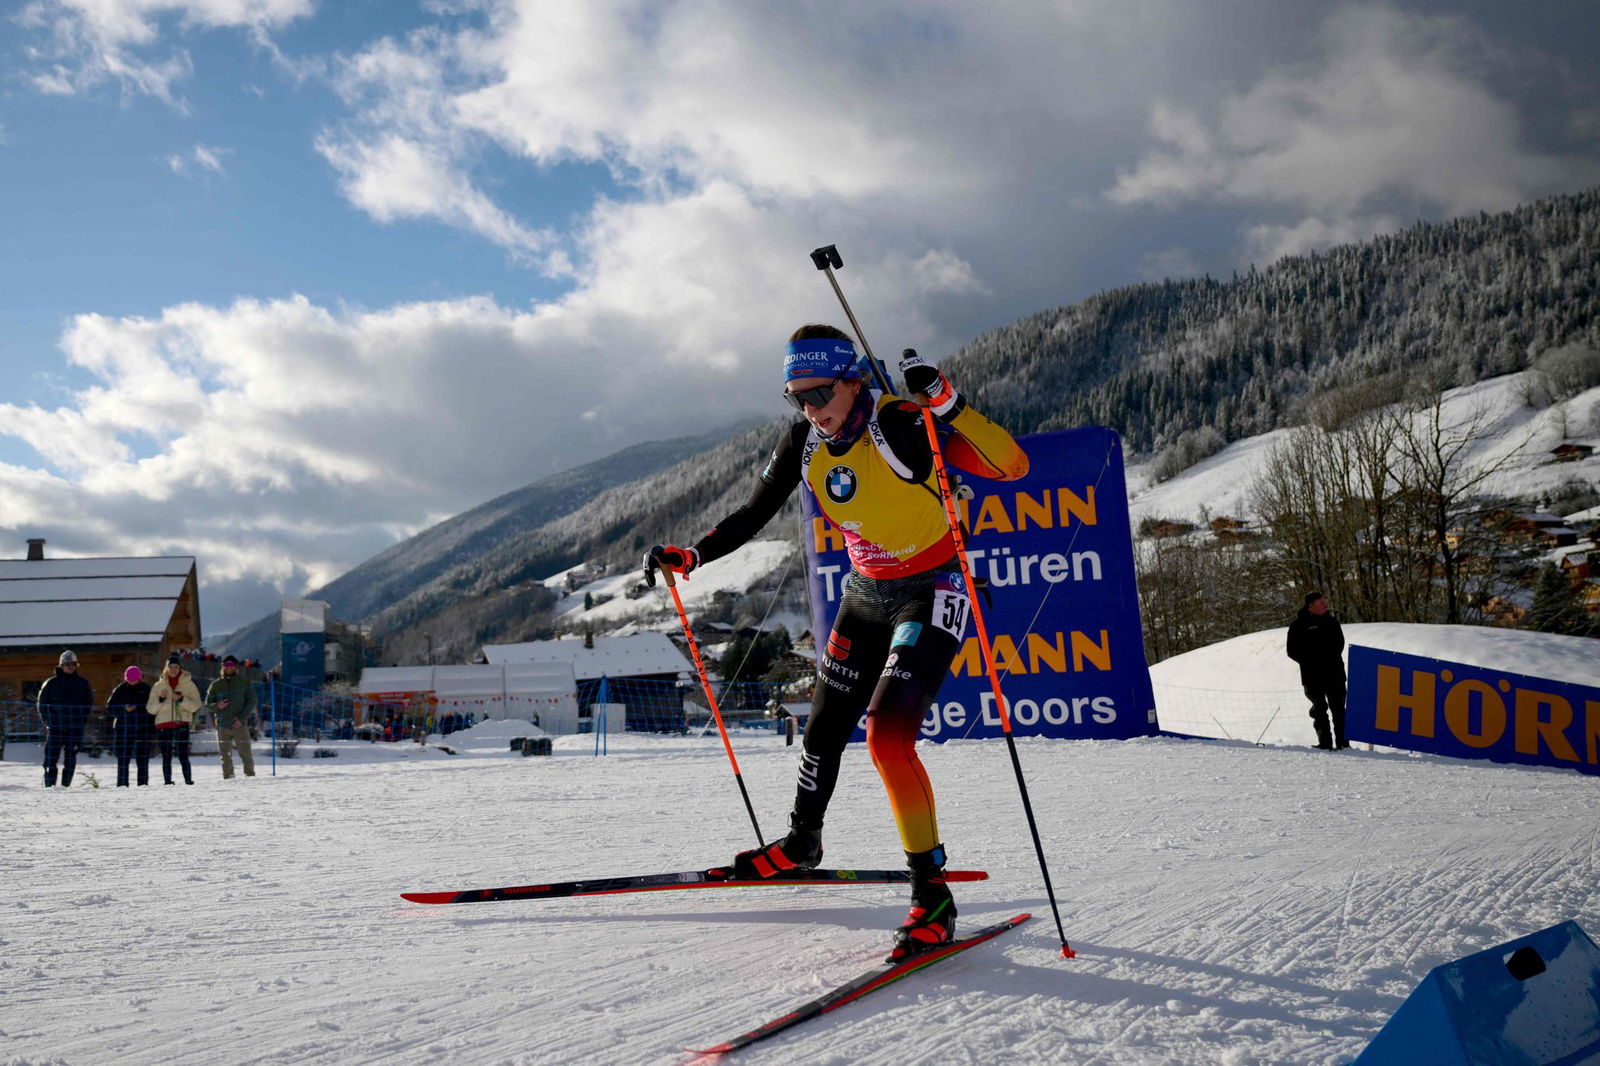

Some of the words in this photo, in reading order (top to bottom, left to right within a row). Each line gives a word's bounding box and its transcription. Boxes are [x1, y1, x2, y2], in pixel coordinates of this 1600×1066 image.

[868, 420, 883, 447] JOKA
[803, 441, 815, 466] JOKA
[966, 547, 1102, 587] Türen
[942, 594, 966, 636] 54
[822, 674, 852, 693] TERREX
[980, 691, 1117, 728] Doors
[1374, 664, 1600, 765] HÖR
